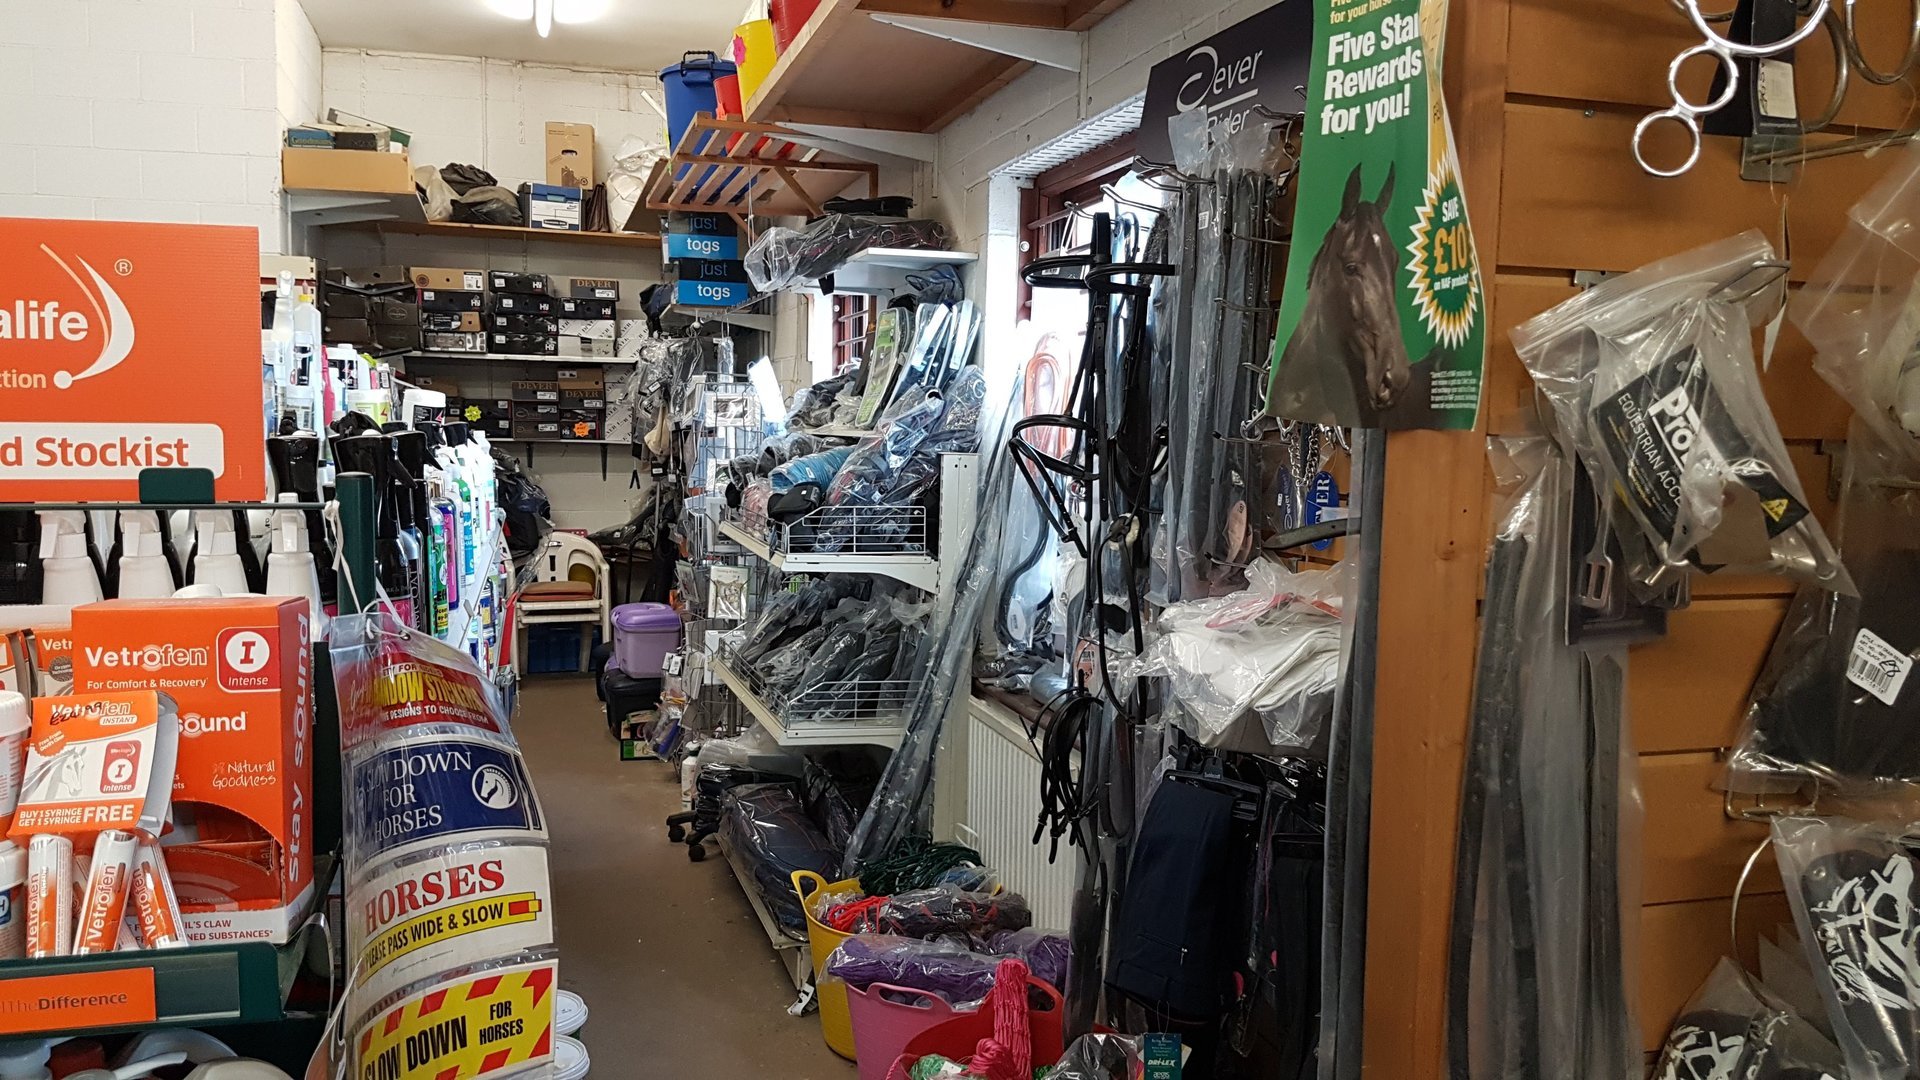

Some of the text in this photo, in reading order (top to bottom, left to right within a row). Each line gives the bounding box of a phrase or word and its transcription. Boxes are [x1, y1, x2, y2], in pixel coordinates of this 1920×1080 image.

[1330, 10, 1345, 24] for
[1348, 4, 1367, 22] your
[1328, 31, 1376, 66] Five
[1176, 45, 1263, 112] Dever
[1324, 46, 1423, 101] Rewards
[1321, 83, 1410, 135] for you!
[1441, 196, 1460, 223] SAVE
[688, 214, 718, 231] just
[687, 237, 721, 254] togs
[1433, 222, 1468, 275] £10
[699, 261, 728, 279] just
[576, 279, 613, 288] DEVER
[697, 284, 731, 299] togs
[0, 368, 47, 389] tion
[518, 382, 554, 391] DEVER
[564, 390, 600, 399] DEVER
[1617, 392, 1665, 470] EQUESTRIAN
[36, 437, 189, 467] Stockist
[84, 641, 256, 668] Vetrofen I
[398, 664, 417, 674] FOR
[87, 677, 207, 689] For Comfort & Recovery
[228, 676, 269, 687] Intense
[294, 613, 310, 767] sound
[423, 673, 486, 712] STICKERS
[102, 716, 136, 724] INSTANT
[390, 704, 422, 720] DESIGNS
[423, 704, 437, 715] TO
[439, 706, 468, 719] CHOOSE
[227, 759, 276, 773] Natural
[393, 751, 472, 781] DOWN
[102, 783, 132, 792] Intense
[212, 775, 277, 789] Goodness
[384, 784, 417, 810] FOR
[18, 816, 81, 827] GET 1 SYRINGE
[20, 807, 83, 819] BUY 1 SYRINGE
[83, 804, 135, 823] FREE
[374, 805, 442, 843] HORSES
[86, 864, 117, 942] Vetrofen
[132, 867, 157, 935] Vetrofen
[365, 860, 505, 938] HORSES
[184, 919, 232, 929] IL'S CLAW
[387, 931, 409, 956] PASS
[410, 918, 444, 943] WIDE
[447, 914, 459, 929] &
[462, 902, 503, 927] SLOW
[189, 933, 206, 941] NED
[406, 1015, 468, 1073] DOWN
[489, 1000, 513, 1021] FOR
[479, 1018, 524, 1046] HORSES
